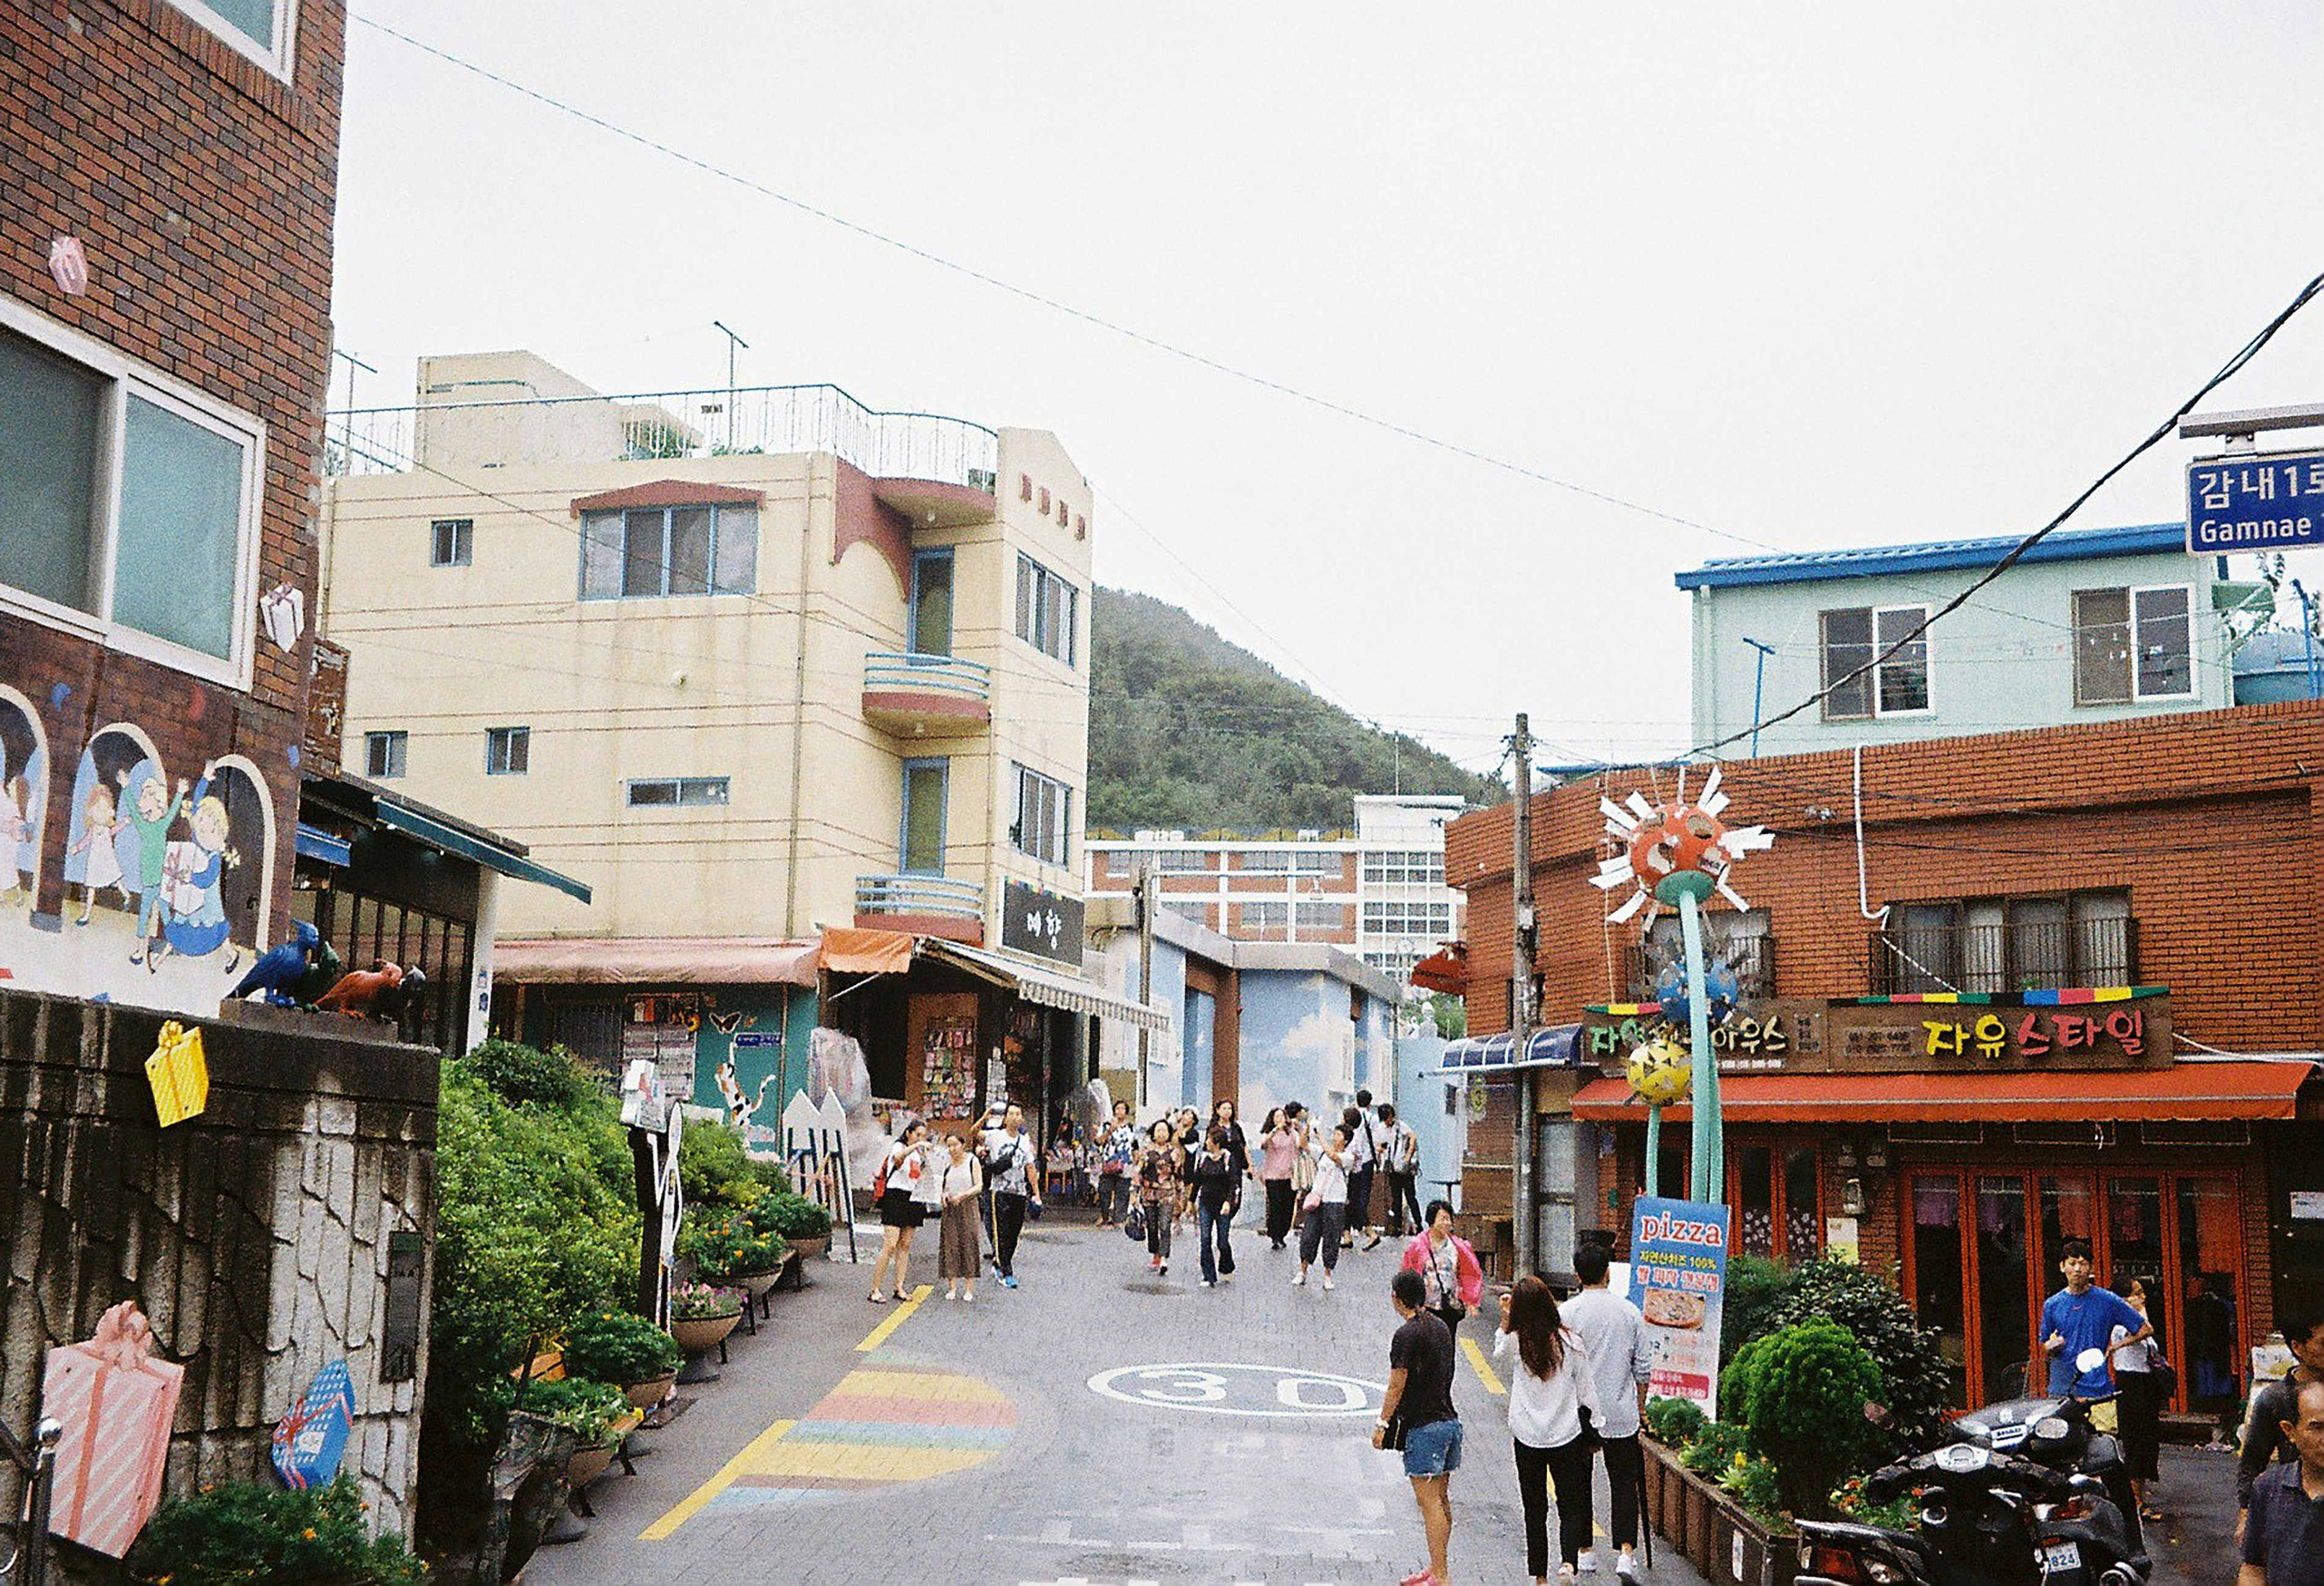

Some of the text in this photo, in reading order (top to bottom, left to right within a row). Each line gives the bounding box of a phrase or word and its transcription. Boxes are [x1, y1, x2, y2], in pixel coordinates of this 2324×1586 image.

[2200, 517, 2311, 543] Gamnae
[1922, 1010, 2144, 1058] 자유 스타일
[1640, 1211, 1722, 1246] pizza
[1138, 1370, 1368, 1410] 30
